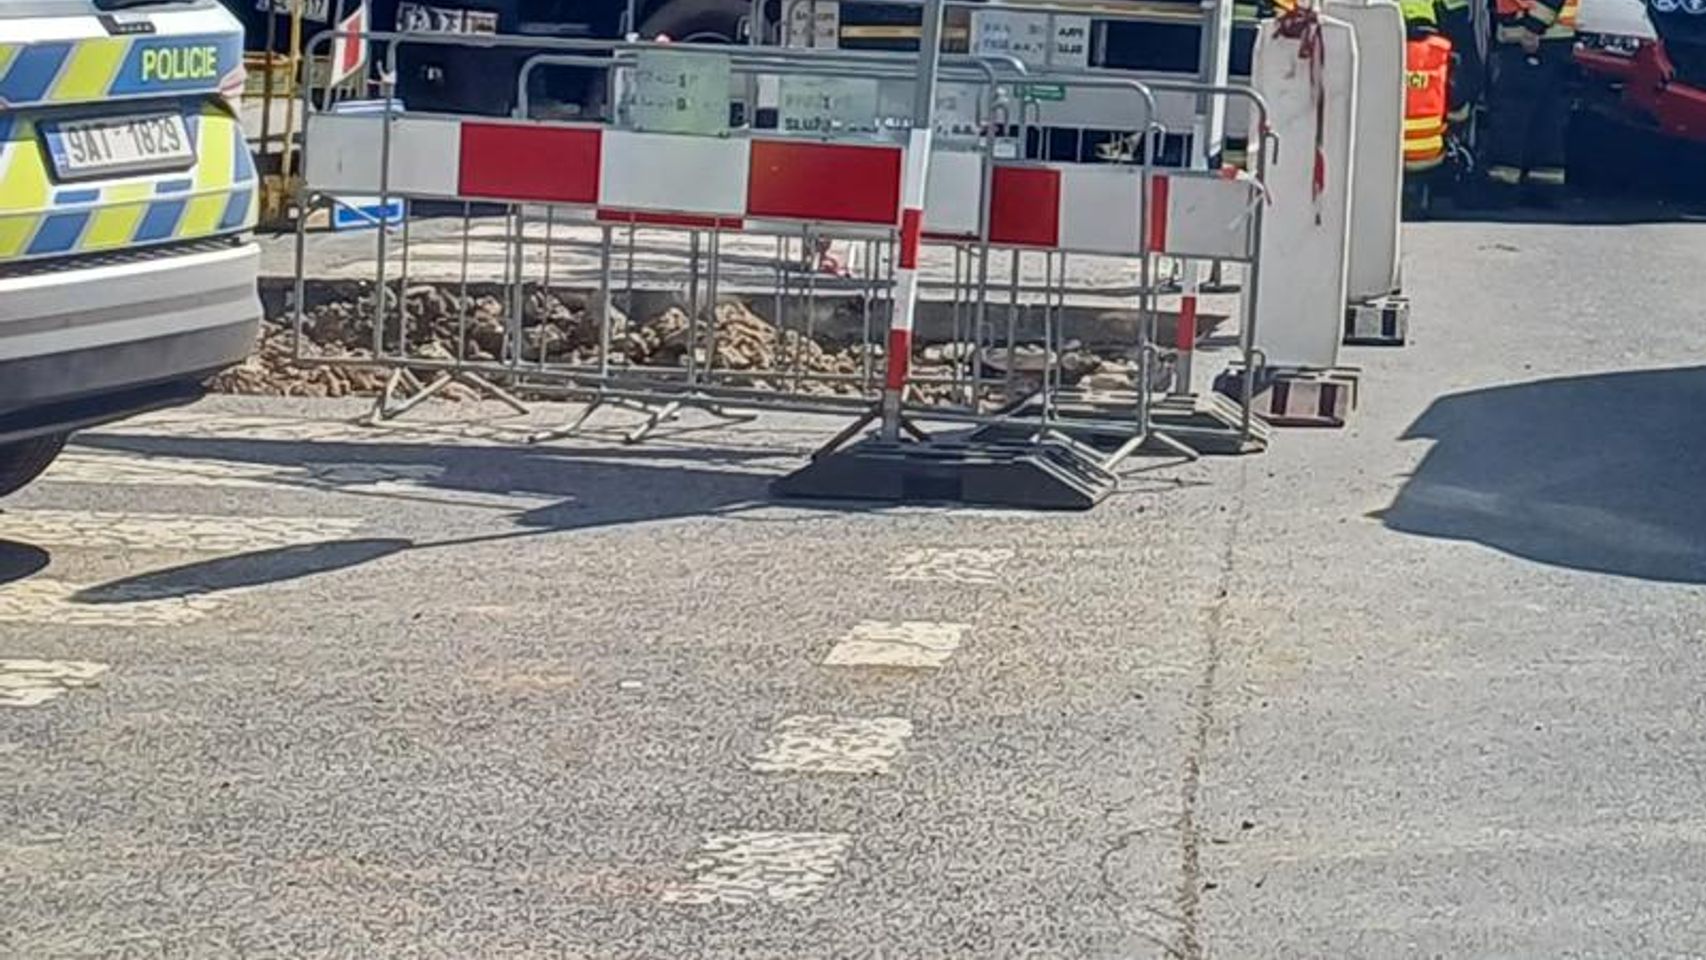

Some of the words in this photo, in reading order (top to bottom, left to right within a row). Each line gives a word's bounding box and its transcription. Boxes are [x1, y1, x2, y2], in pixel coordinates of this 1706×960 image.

[141, 46, 218, 81] POLICIE
[67, 121, 113, 163] 9AT
[129, 116, 181, 156] 1829
